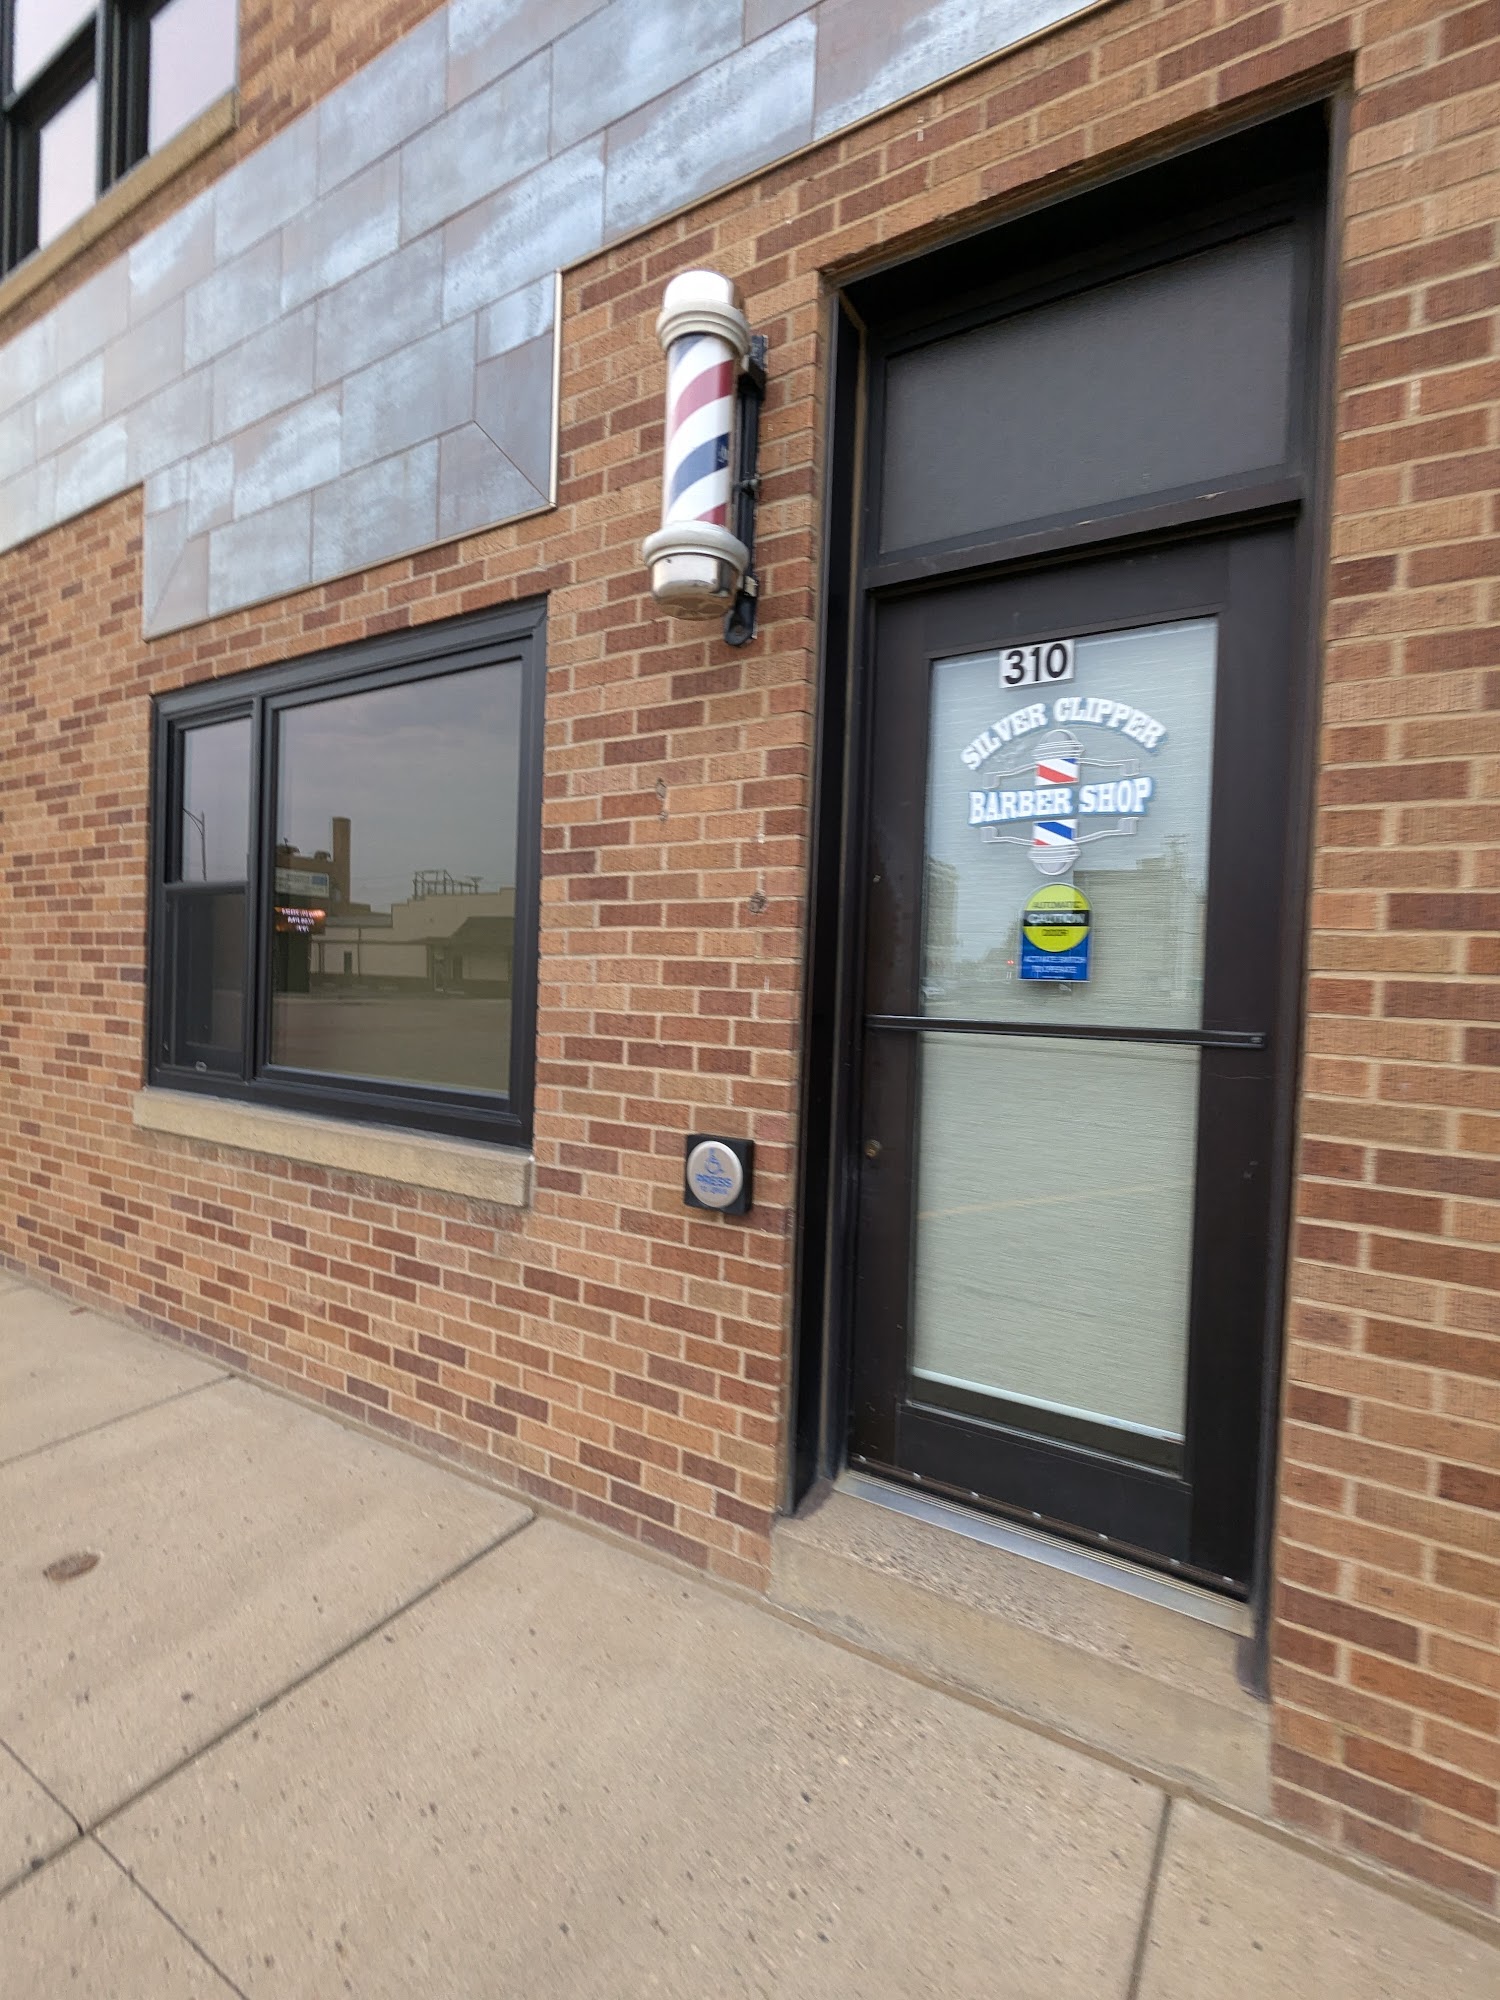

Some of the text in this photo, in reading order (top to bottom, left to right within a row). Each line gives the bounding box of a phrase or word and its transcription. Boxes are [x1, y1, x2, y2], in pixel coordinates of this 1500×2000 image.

[1004, 642, 1069, 684] 310
[960, 696, 1168, 770] SILVER CLIPPER
[968, 777, 1154, 826] BARBER SHOP
[695, 1173, 733, 1189] PRESS
